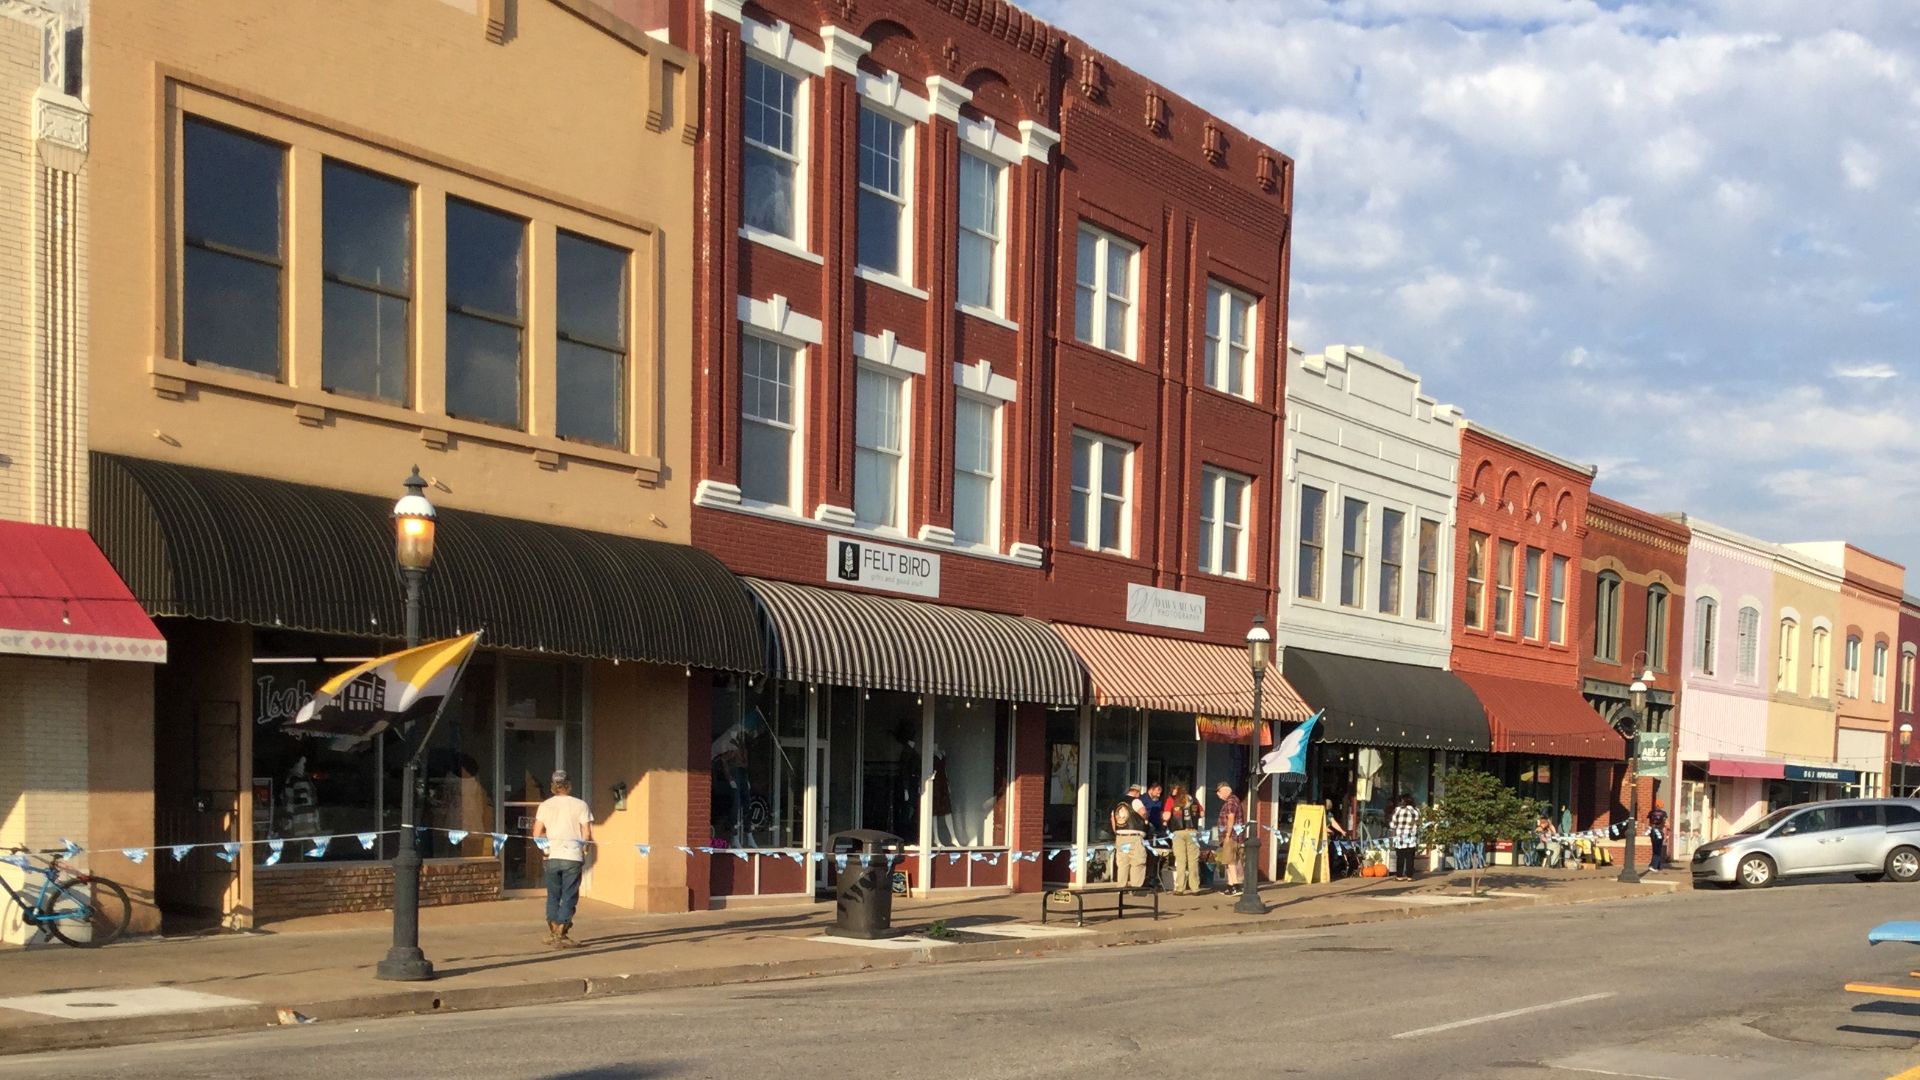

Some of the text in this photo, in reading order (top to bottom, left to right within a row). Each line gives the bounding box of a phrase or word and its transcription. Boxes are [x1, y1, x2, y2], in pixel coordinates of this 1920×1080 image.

[864, 549, 931, 578] FELT BIRD
[1157, 608, 1200, 621] PHOTOGRAPHY
[1641, 747, 1658, 757] ARTS
